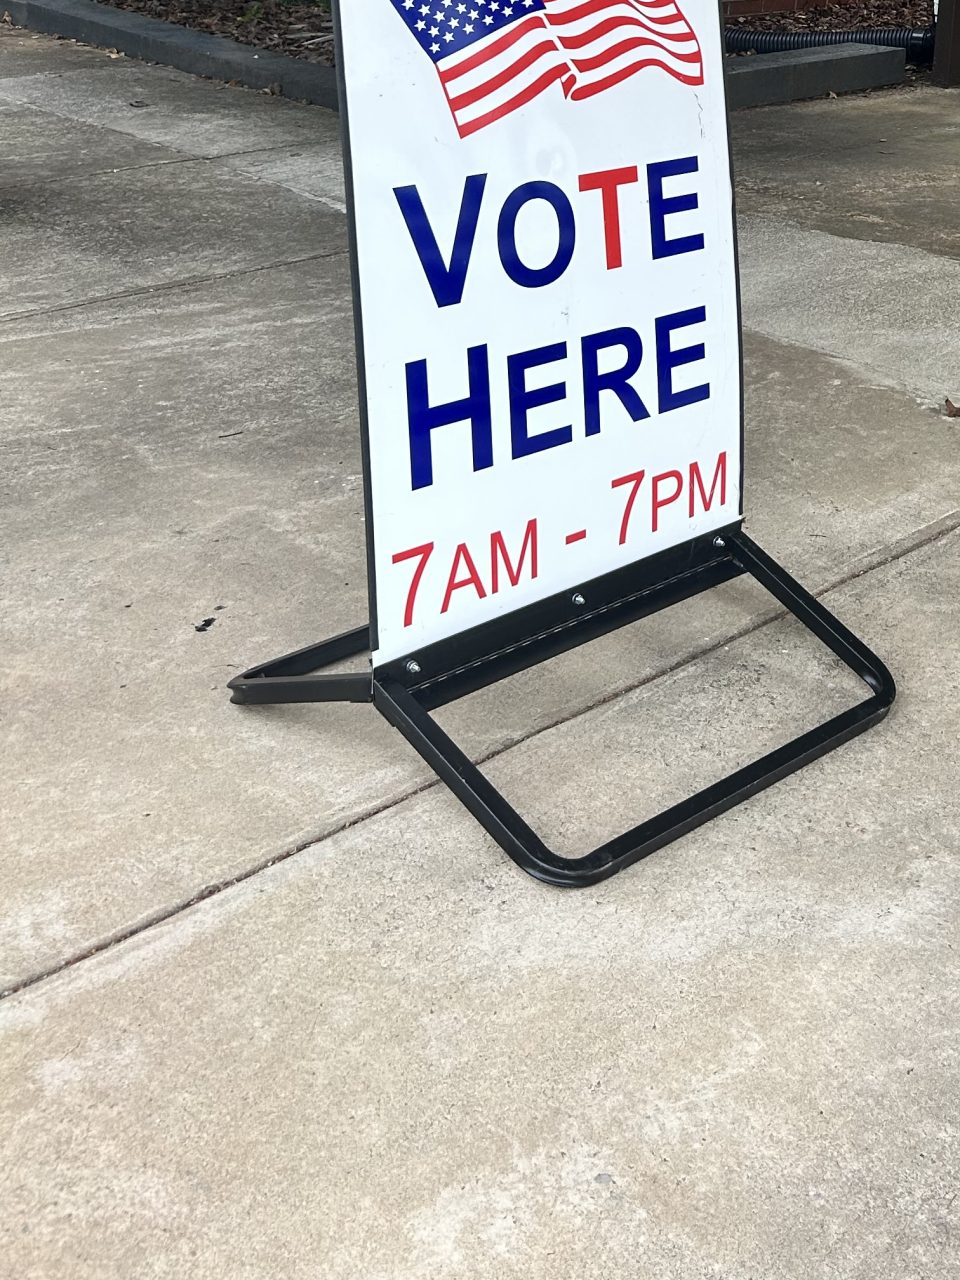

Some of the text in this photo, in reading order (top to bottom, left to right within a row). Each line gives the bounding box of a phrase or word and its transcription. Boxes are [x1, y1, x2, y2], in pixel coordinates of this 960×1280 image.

[393, 155, 704, 308] VOTE
[405, 306, 710, 490] HERE
[392, 452, 727, 627] 7AM - 7PM
